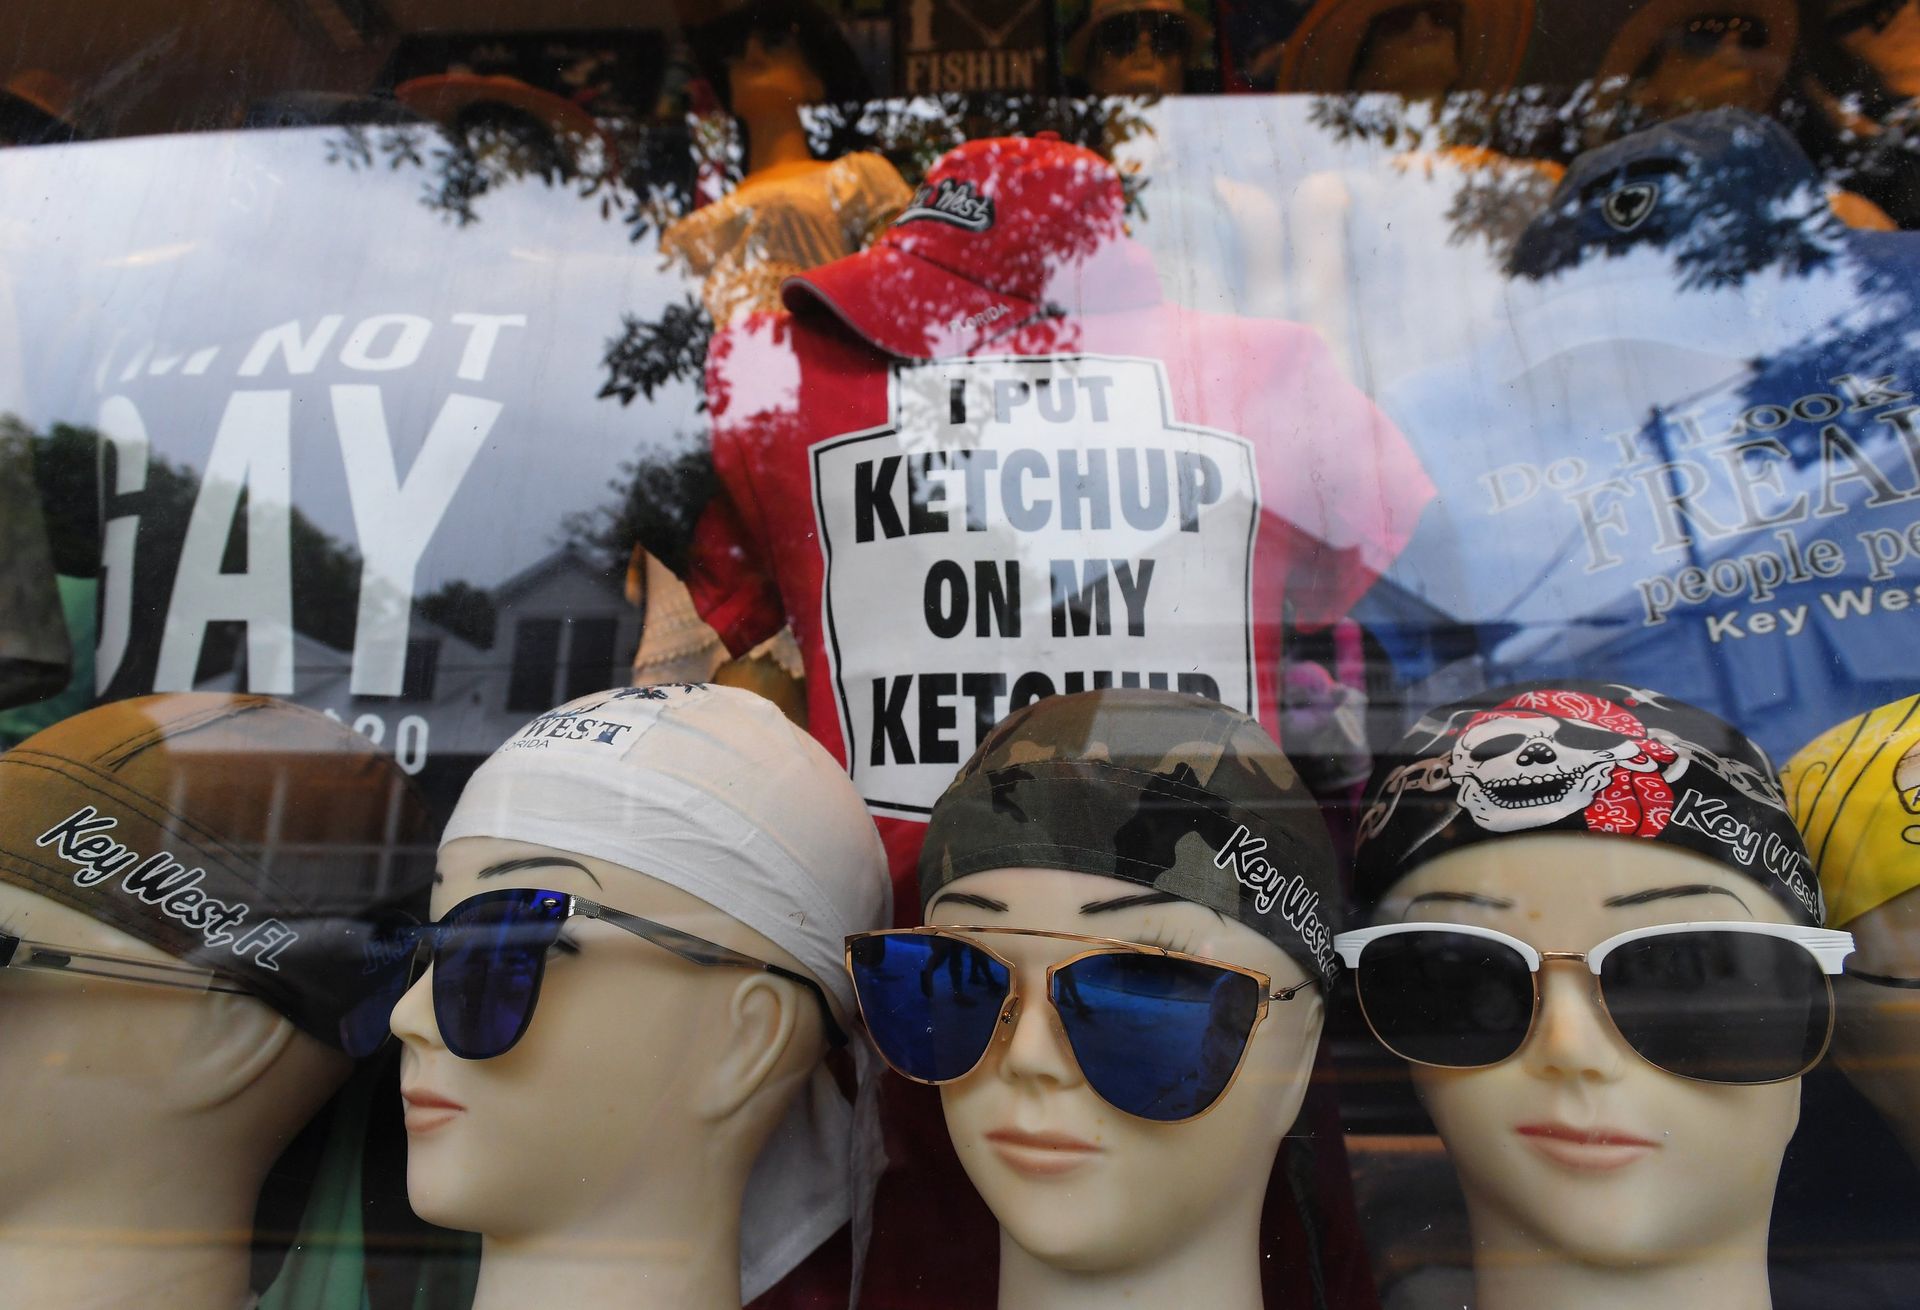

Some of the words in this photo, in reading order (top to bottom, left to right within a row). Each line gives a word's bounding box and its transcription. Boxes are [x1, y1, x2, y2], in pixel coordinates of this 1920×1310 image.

[907, 48, 1046, 91] FISHIN'
[236, 313, 527, 381] NOT
[949, 377, 967, 425] I
[994, 375, 1114, 424] PUT
[854, 446, 1223, 544] KETCHUP
[923, 559, 1022, 640] ON
[1049, 558, 1156, 638] MY
[1634, 527, 1847, 627] people
[1706, 603, 1810, 644] Key
[523, 716, 632, 746] WEST
[35, 805, 139, 888] Key
[121, 851, 249, 948] West,
[231, 918, 299, 973] FL
[1213, 824, 1286, 915] Key
[1670, 788, 1762, 866] Key
[1763, 832, 1824, 926] West
